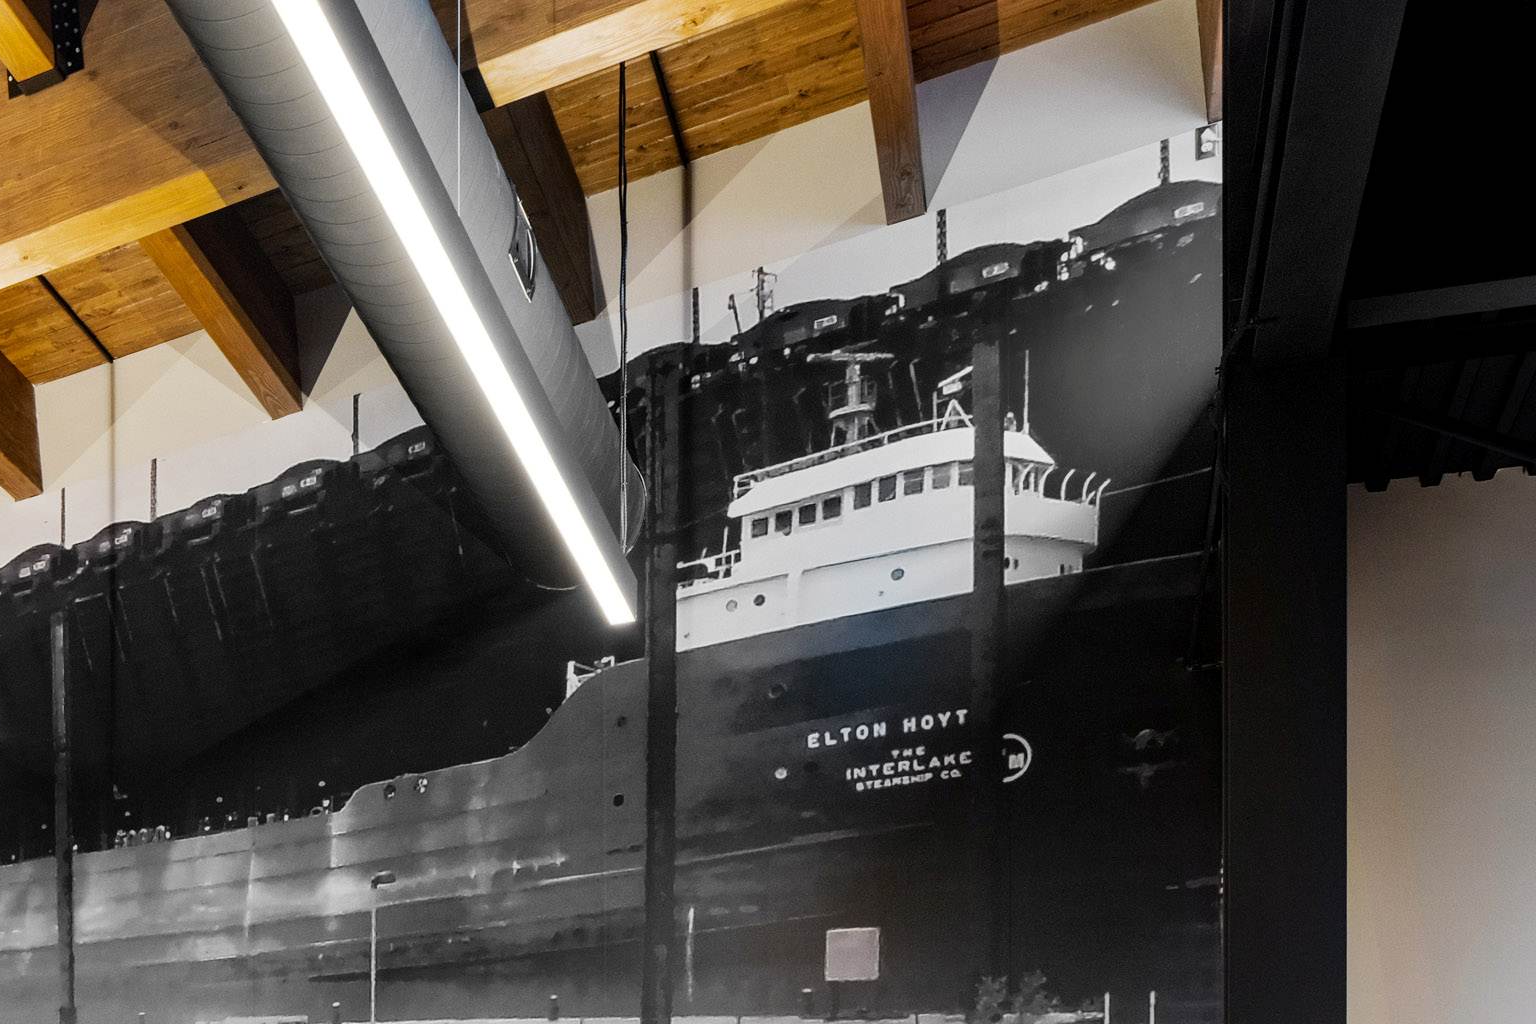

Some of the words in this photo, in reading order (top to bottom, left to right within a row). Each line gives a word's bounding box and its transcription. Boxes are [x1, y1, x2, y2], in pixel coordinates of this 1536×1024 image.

[807, 721, 887, 748] ELTON
[902, 709, 968, 732] HOYT
[846, 751, 972, 780] INTERLAKE
[891, 746, 926, 759] THE
